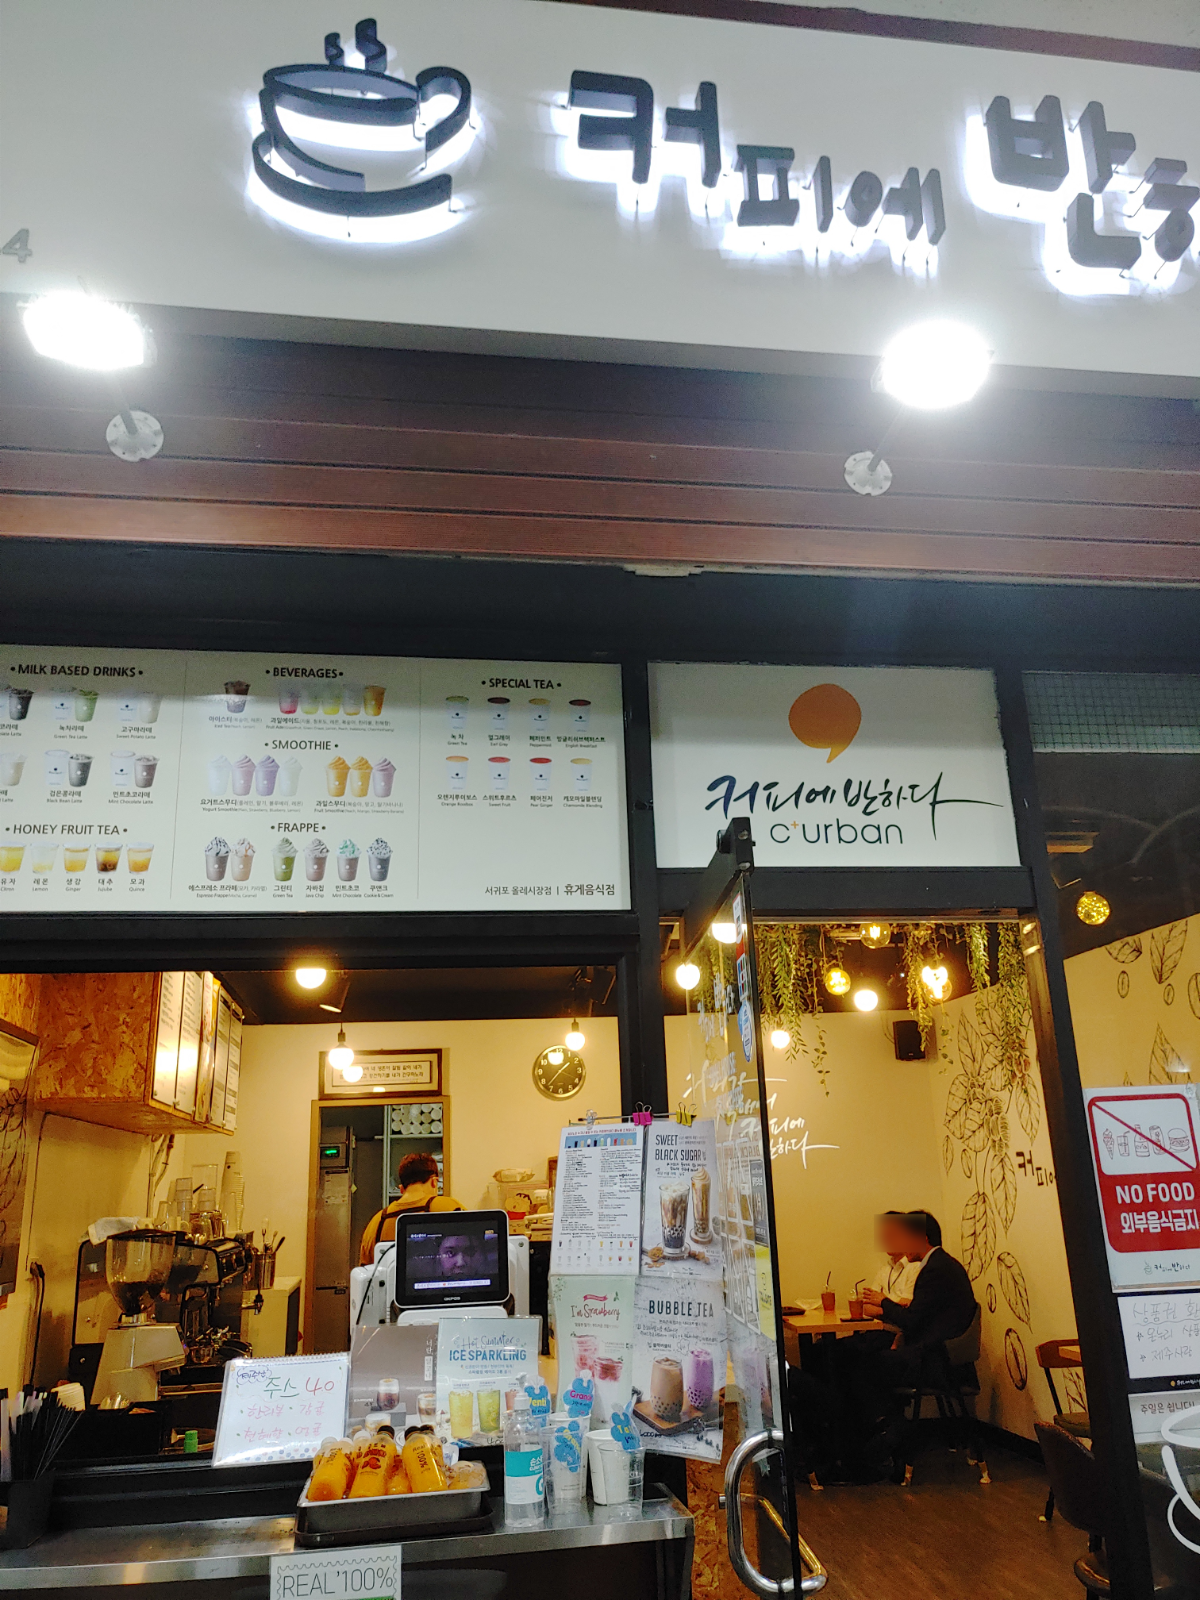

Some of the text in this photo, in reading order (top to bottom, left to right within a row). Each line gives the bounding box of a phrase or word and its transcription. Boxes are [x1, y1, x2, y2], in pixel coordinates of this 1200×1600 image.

[568, 69, 946, 246] 커피에
[18, 664, 136, 677] MILK BASED DRINKS
[273, 667, 338, 679] BEVERAGES
[489, 678, 554, 689] SPECIAL TEA
[121, 725, 153, 734] 고구마라떼
[271, 739, 332, 751] SMOOTHIE
[50, 790, 82, 798] 검은콩라떼
[112, 790, 151, 799] 민트초코라떼
[705, 772, 1004, 840] 커피에 반하다
[13, 824, 121, 836] HONEY FRUIT TEA
[277, 822, 320, 833] FRAPPE
[485, 884, 616, 896] 서귀포 올레시장점 휴게음식점
[655, 1134, 678, 1146] SWEET
[655, 1148, 702, 1161] BLACK SUGAR
[1116, 1181, 1196, 1204] NO FOOD
[1120, 1208, 1200, 1234] 외부음식금지
[584, 1302, 621, 1321] Strawberry
[648, 1300, 714, 1318] BUBBLE TEA
[1132, 1302, 1177, 1323] 상품권
[1147, 1327, 1173, 1342] 온누리
[460, 1335, 479, 1350] Hot
[449, 1349, 528, 1362] ICE SPARKLING
[1150, 1346, 1193, 1362] 제주사랑
[264, 1376, 300, 1399] 주스
[1140, 1402, 1165, 1415] 주일은
